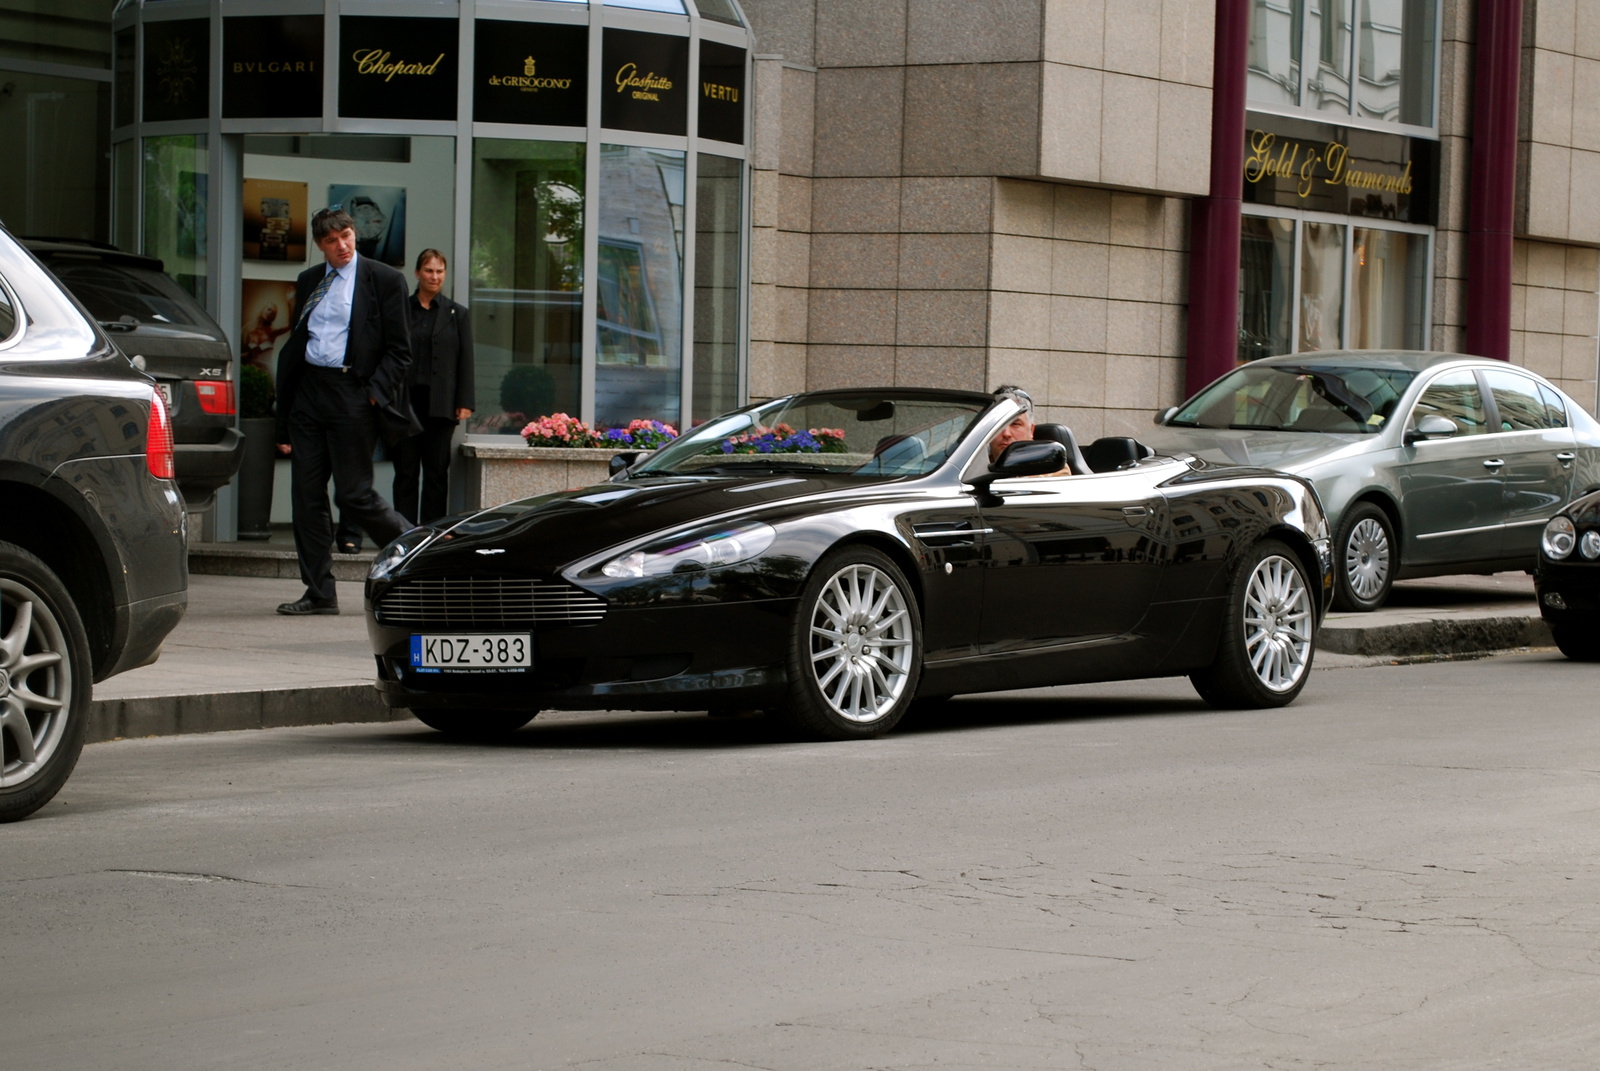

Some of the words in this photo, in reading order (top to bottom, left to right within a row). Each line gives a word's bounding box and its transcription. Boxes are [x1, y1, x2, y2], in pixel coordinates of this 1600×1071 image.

[233, 61, 314, 73] BVLGARI
[352, 48, 445, 82] Chopard
[488, 75, 501, 86] de
[502, 75, 570, 89] GRISOGONO
[631, 90, 660, 102] ORIGINAL
[703, 81, 739, 103] VERTU
[1244, 128, 1299, 183] Gold
[1297, 147, 1322, 198] &
[1323, 141, 1413, 195] Diamonds
[199, 367, 222, 376] X5
[425, 637, 525, 663] KDZ-383
[413, 653, 420, 662] H
